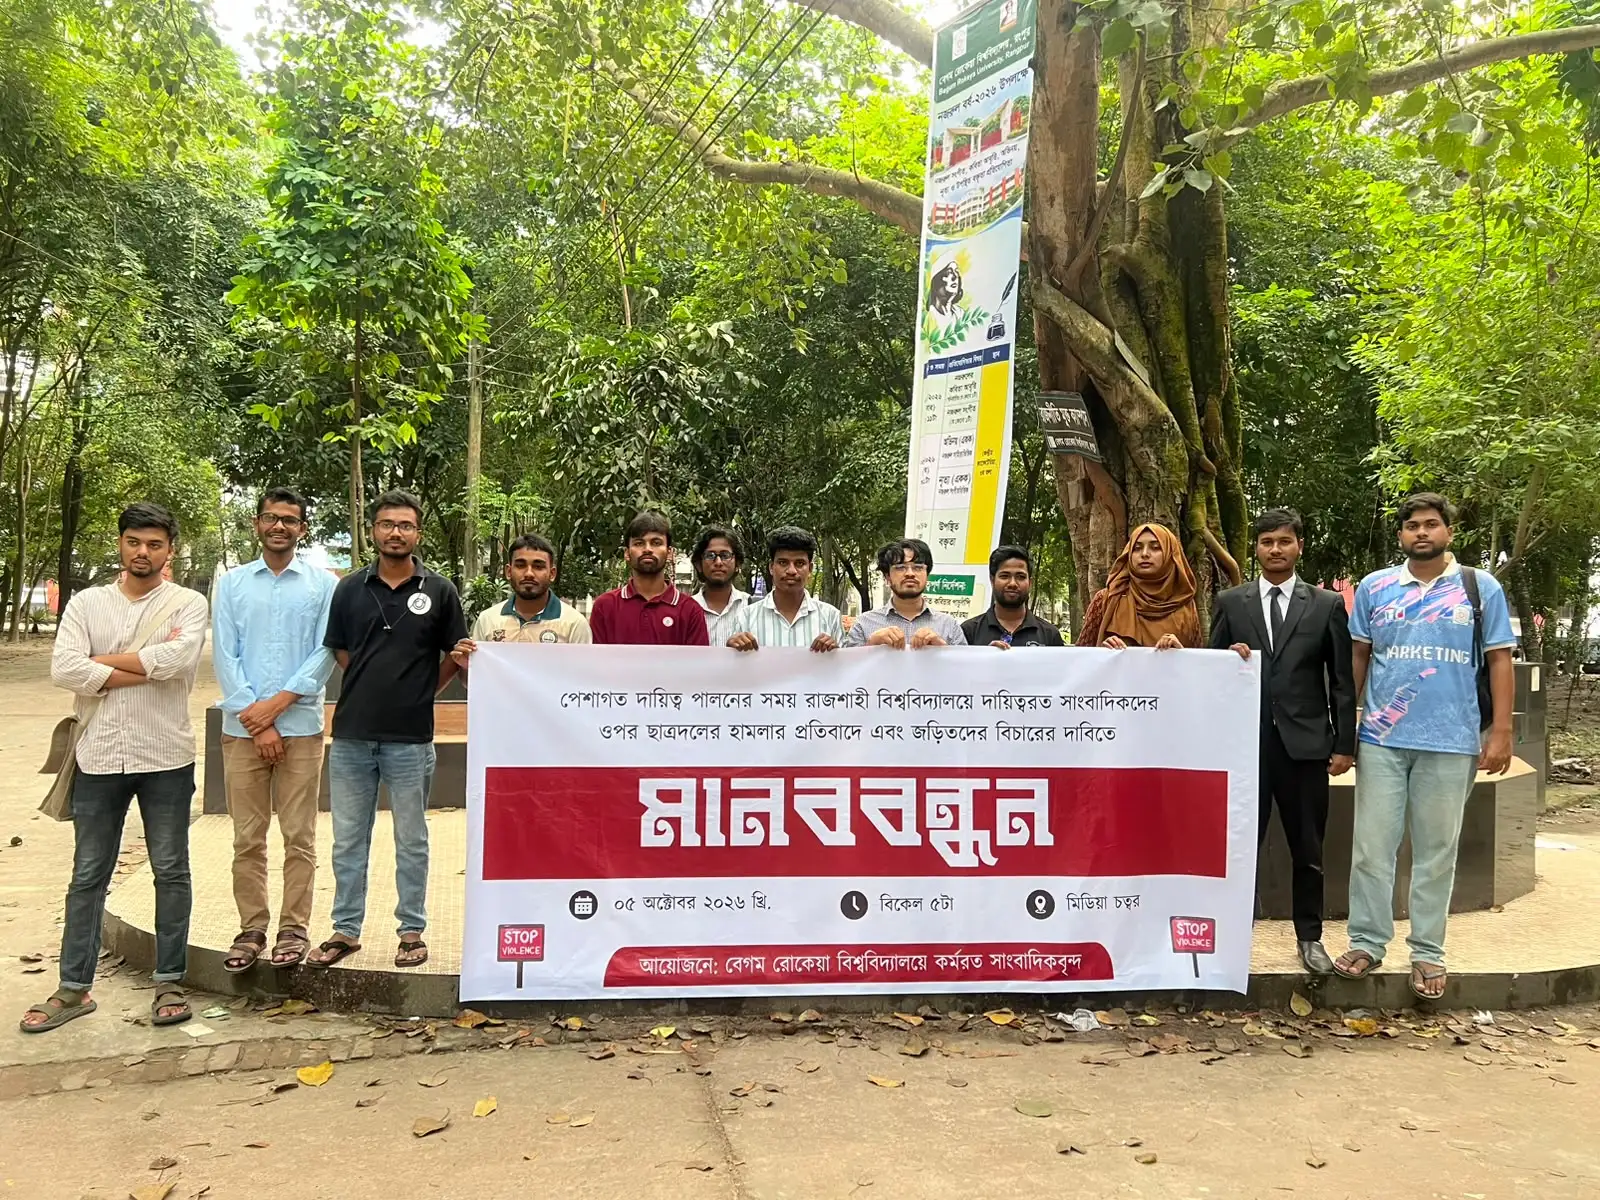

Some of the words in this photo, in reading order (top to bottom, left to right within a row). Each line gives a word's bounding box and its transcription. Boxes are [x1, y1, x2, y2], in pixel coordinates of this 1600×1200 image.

[1005, 41, 1030, 60] Rangpur
[561, 692, 627, 708] পেশাগত
[636, 687, 682, 710] দায়িত্ব
[692, 692, 752, 708] পালনের
[760, 694, 796, 708] সময়
[804, 688, 869, 710] রাজশাহী
[877, 688, 973, 710] বিশ্ববিদ্যালয়ে
[981, 690, 1052, 712] দায়িত্বরত
[1060, 690, 1159, 711] সাংবাদিকদের
[600, 725, 638, 739] ওপর
[647, 725, 720, 741] ছাত্রদলের
[728, 724, 786, 741] হামলার
[795, 719, 862, 740] প্রতিবাদে
[871, 726, 903, 740] এবং
[911, 720, 988, 744] জড়িতদের
[995, 721, 1055, 741] বিচারের
[1064, 721, 1115, 741] দাবিতে
[639, 778, 1054, 867] মানববন্ধন
[615, 898, 635, 911] ০৫
[643, 893, 696, 910] অক্টোবর
[704, 897, 744, 910] ২০২৬
[752, 891, 770, 909] খ্রি.
[880, 894, 923, 911] বিকেল
[931, 895, 953, 911] ৫টা
[1066, 893, 1107, 910] মিডিয়া
[1114, 895, 1140, 910] চত্বর
[504, 930, 538, 944] STOP
[1177, 923, 1209, 936] STOP
[502, 946, 541, 955] VIOLENCE
[1176, 938, 1211, 948] VIOLENCE
[639, 957, 717, 974] আয়োজনে:
[726, 956, 765, 973] বেগম
[773, 955, 830, 972] রোকেয়া
[836, 950, 927, 973] বিশ্ববিদ্যালয়ে
[934, 949, 982, 969] কর্মরত
[989, 949, 1082, 975] সাংবাদিকবৃন্দ
